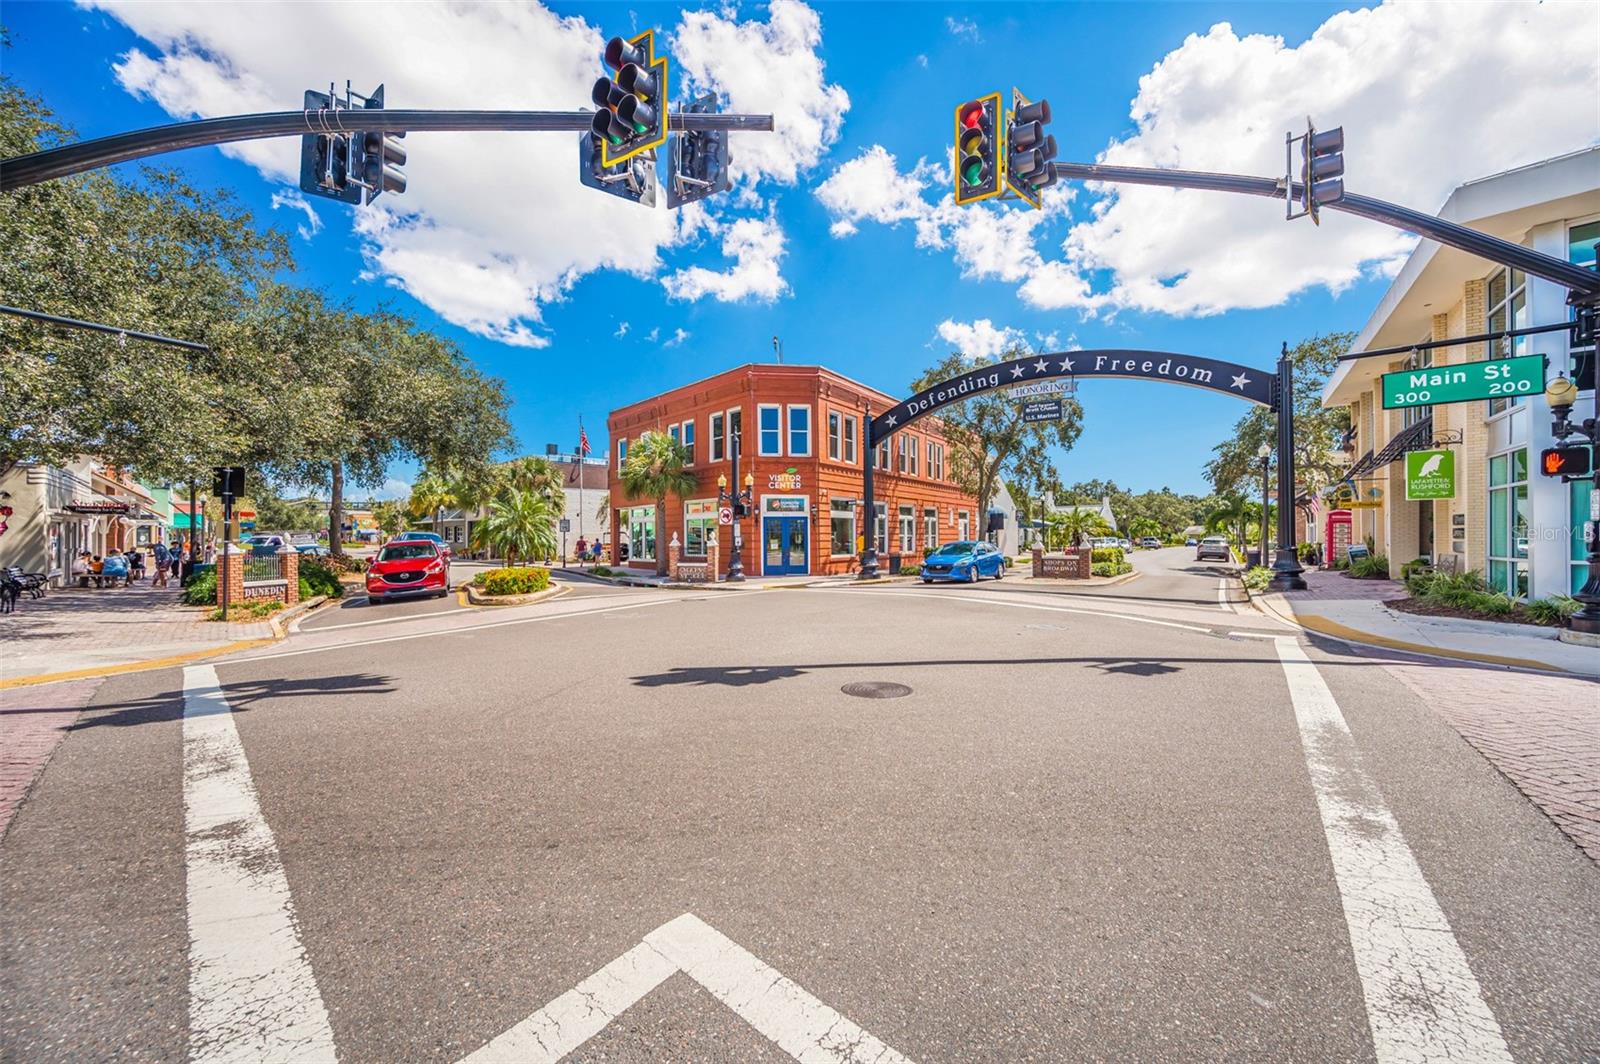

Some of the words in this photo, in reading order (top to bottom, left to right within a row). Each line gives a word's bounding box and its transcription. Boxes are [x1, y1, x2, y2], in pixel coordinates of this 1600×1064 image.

[907, 373, 999, 416] Defending
[1094, 355, 1213, 383] Freedom
[1410, 370, 1466, 388] Main
[1484, 364, 1511, 380] St
[1015, 383, 1068, 396] HONORING
[1394, 391, 1431, 404] 300
[1489, 380, 1531, 395] 200
[245, 586, 286, 597] DUNEDIN
